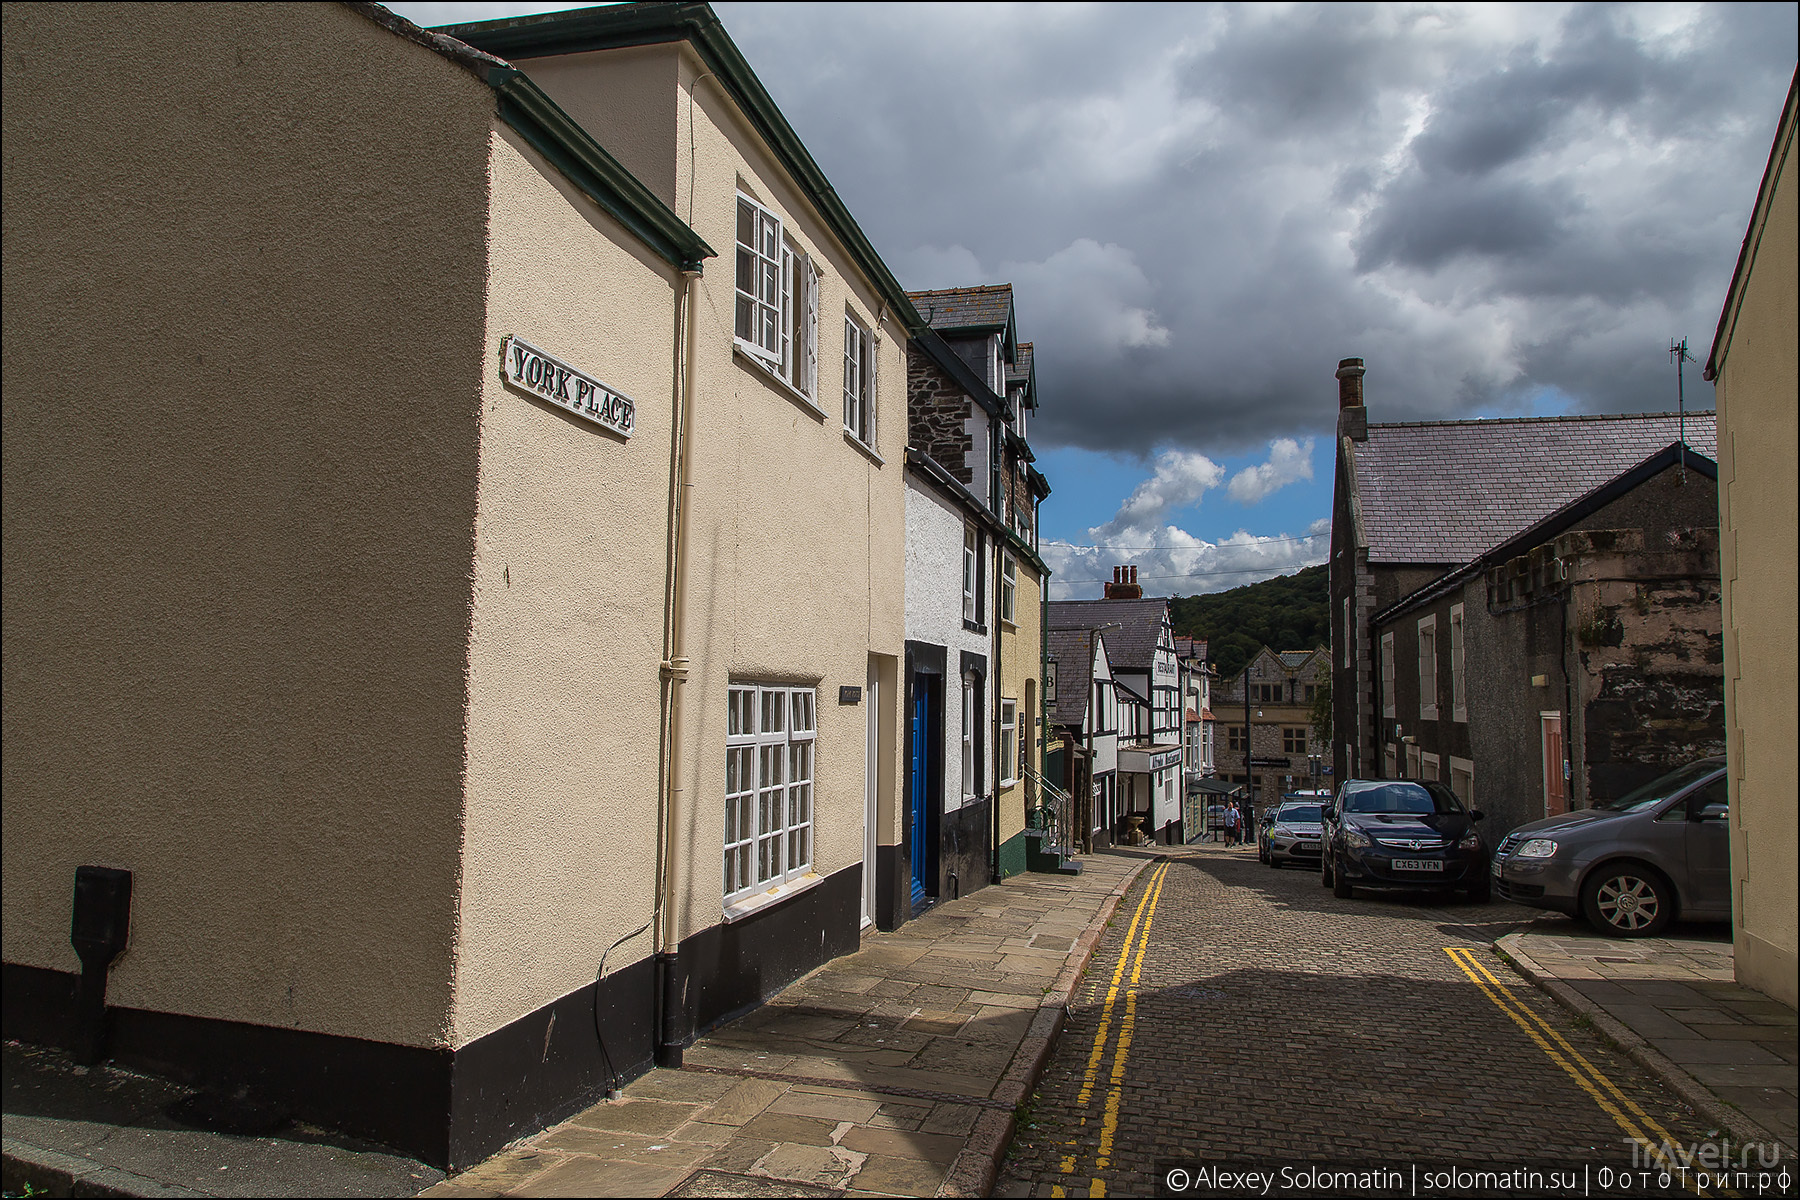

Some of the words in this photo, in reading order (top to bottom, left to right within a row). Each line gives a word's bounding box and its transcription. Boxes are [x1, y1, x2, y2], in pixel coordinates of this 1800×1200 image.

[513, 346, 571, 403] YORK
[573, 378, 633, 432] PLACE
[1395, 860, 1420, 869] CX63
[1421, 861, 1440, 870] VFN
